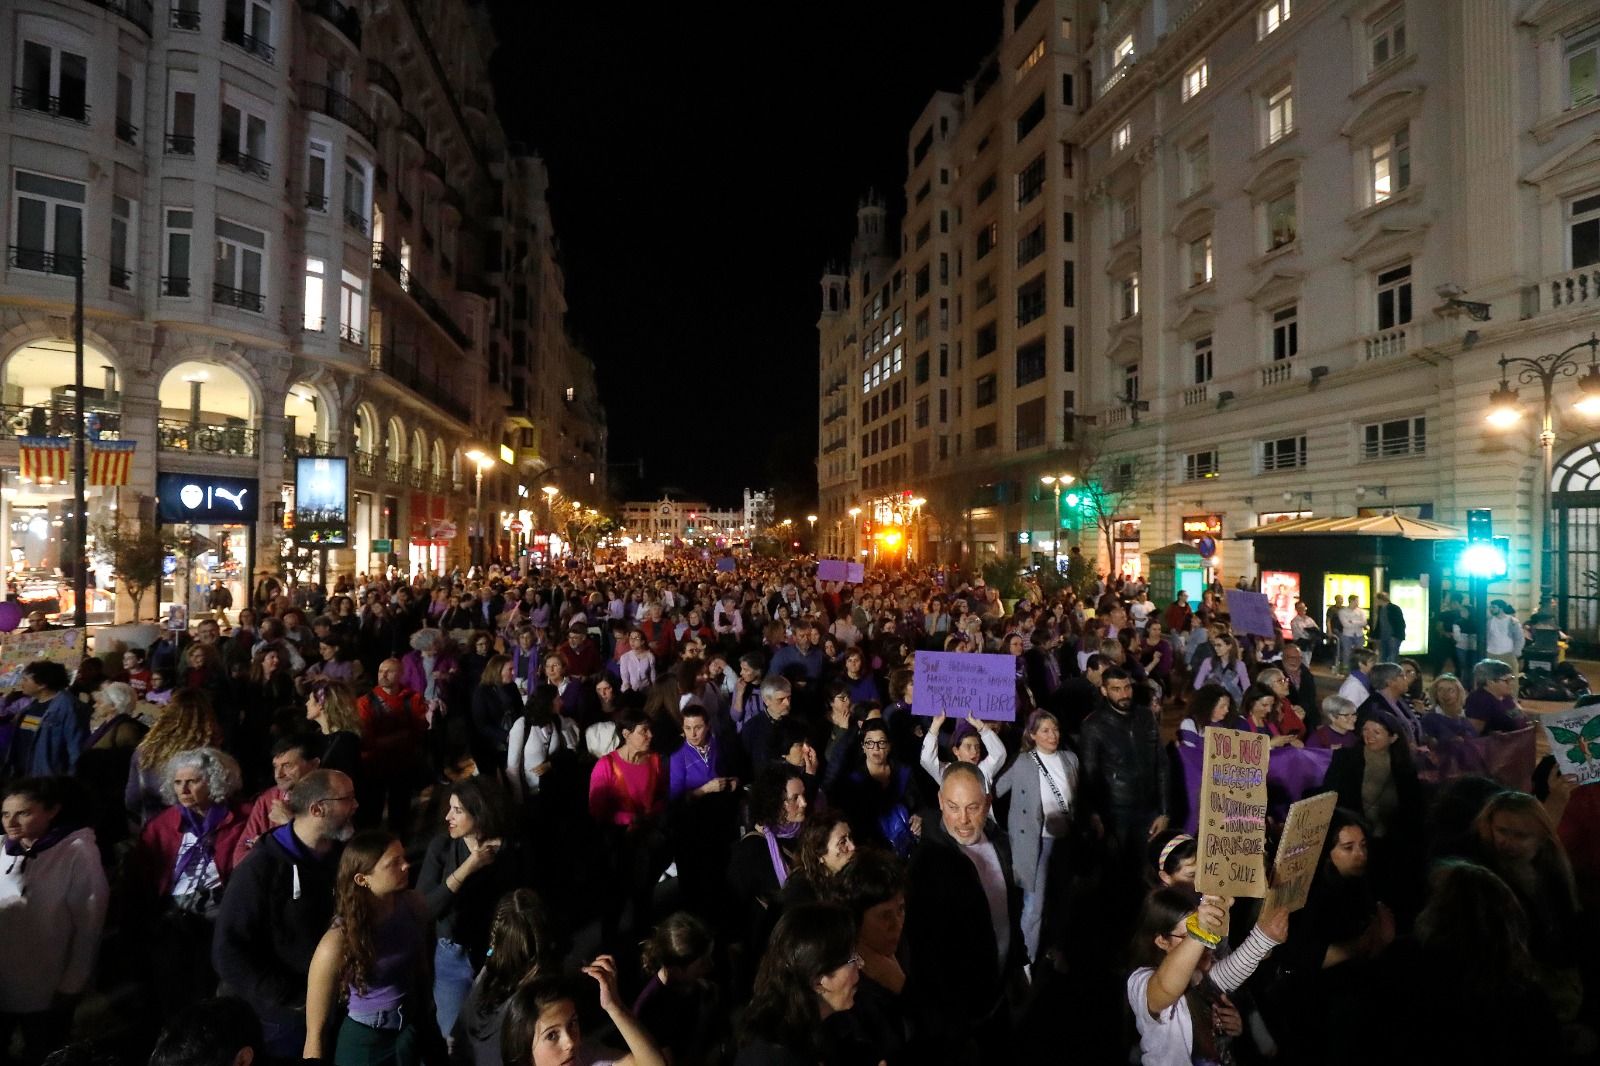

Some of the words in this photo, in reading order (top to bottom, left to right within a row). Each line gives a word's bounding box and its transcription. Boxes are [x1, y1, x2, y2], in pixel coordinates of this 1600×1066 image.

[930, 692, 973, 710] PRIMER
[978, 693, 1015, 713] LIBRO
[1213, 732, 1232, 759] YO
[1239, 739, 1263, 766] NO
[1204, 861, 1219, 876] ME
[1228, 861, 1257, 883] SALVE
